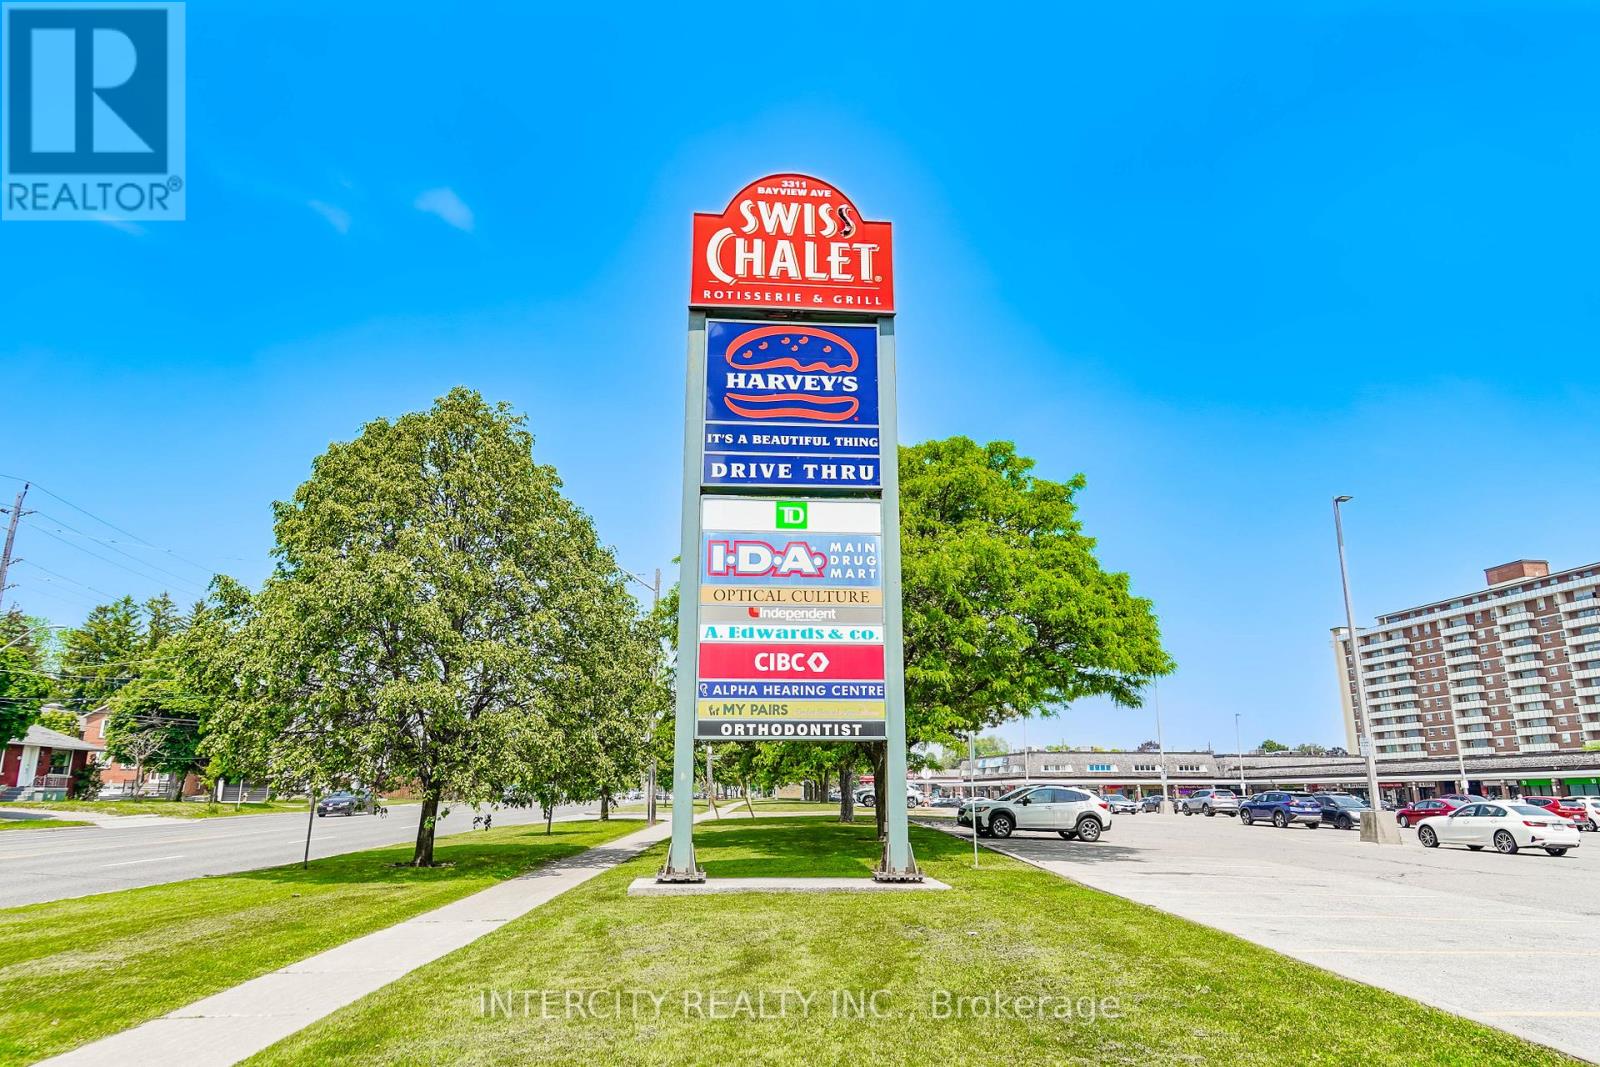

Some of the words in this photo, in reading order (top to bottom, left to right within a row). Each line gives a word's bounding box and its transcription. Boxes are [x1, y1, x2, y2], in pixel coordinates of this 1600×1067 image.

[781, 180, 807, 188] 3311
[757, 187, 807, 196] BAYVIEW
[810, 189, 832, 197] AVE
[739, 199, 856, 239] SWISS
[706, 227, 880, 285] CHALET
[704, 290, 801, 303] ROTISSERIE
[813, 294, 823, 303] &
[833, 295, 882, 305] GRILL
[726, 372, 858, 392] HARVEY'S
[708, 433, 733, 443] IT'S
[738, 435, 747, 444] A
[752, 435, 830, 446] BEAUTIFUL
[834, 437, 878, 447] THING
[711, 463, 792, 479] DRIVE
[803, 464, 873, 480] THRU
[779, 507, 804, 524] TD
[830, 543, 875, 552] MAIN
[830, 556, 877, 566] DRUG
[830, 569, 876, 578] MART
[713, 589, 786, 602] OPTICAL
[792, 591, 869, 603] CULTURE
[760, 607, 836, 621] Independent
[705, 626, 723, 638] A.
[729, 627, 824, 639] Edwards
[828, 628, 843, 639] &
[754, 653, 805, 671] CIBC
[713, 685, 757, 695] ALPHA
[763, 686, 826, 695] HEARING
[832, 686, 883, 696] CENTRE
[723, 704, 746, 715] MY
[750, 704, 788, 715] PAIRS
[720, 724, 862, 735] ORTHODONTIST
